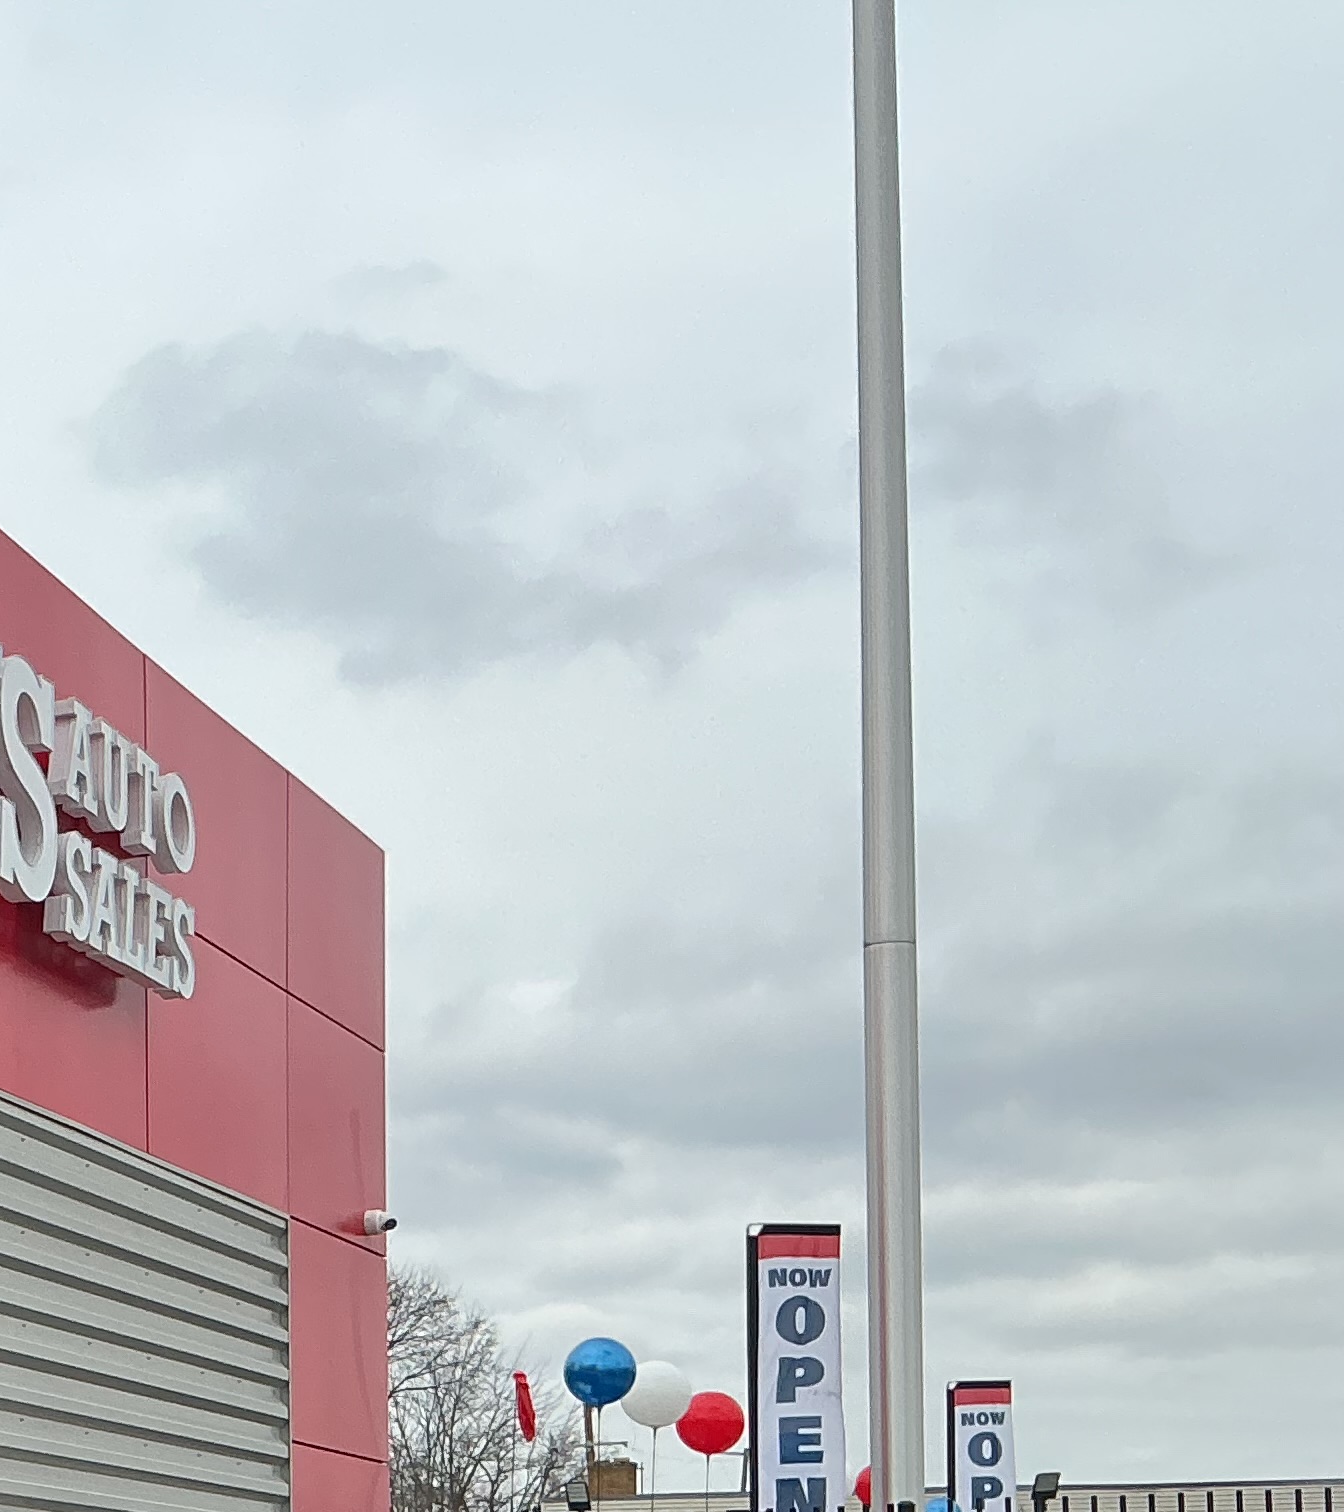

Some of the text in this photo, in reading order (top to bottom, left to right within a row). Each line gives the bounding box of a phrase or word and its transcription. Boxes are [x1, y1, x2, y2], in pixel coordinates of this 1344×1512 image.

[50, 696, 197, 874] AUTO
[47, 830, 196, 1000] SALES
[767, 1267, 833, 1289] NOW
[961, 1411, 1006, 1426] NOW
